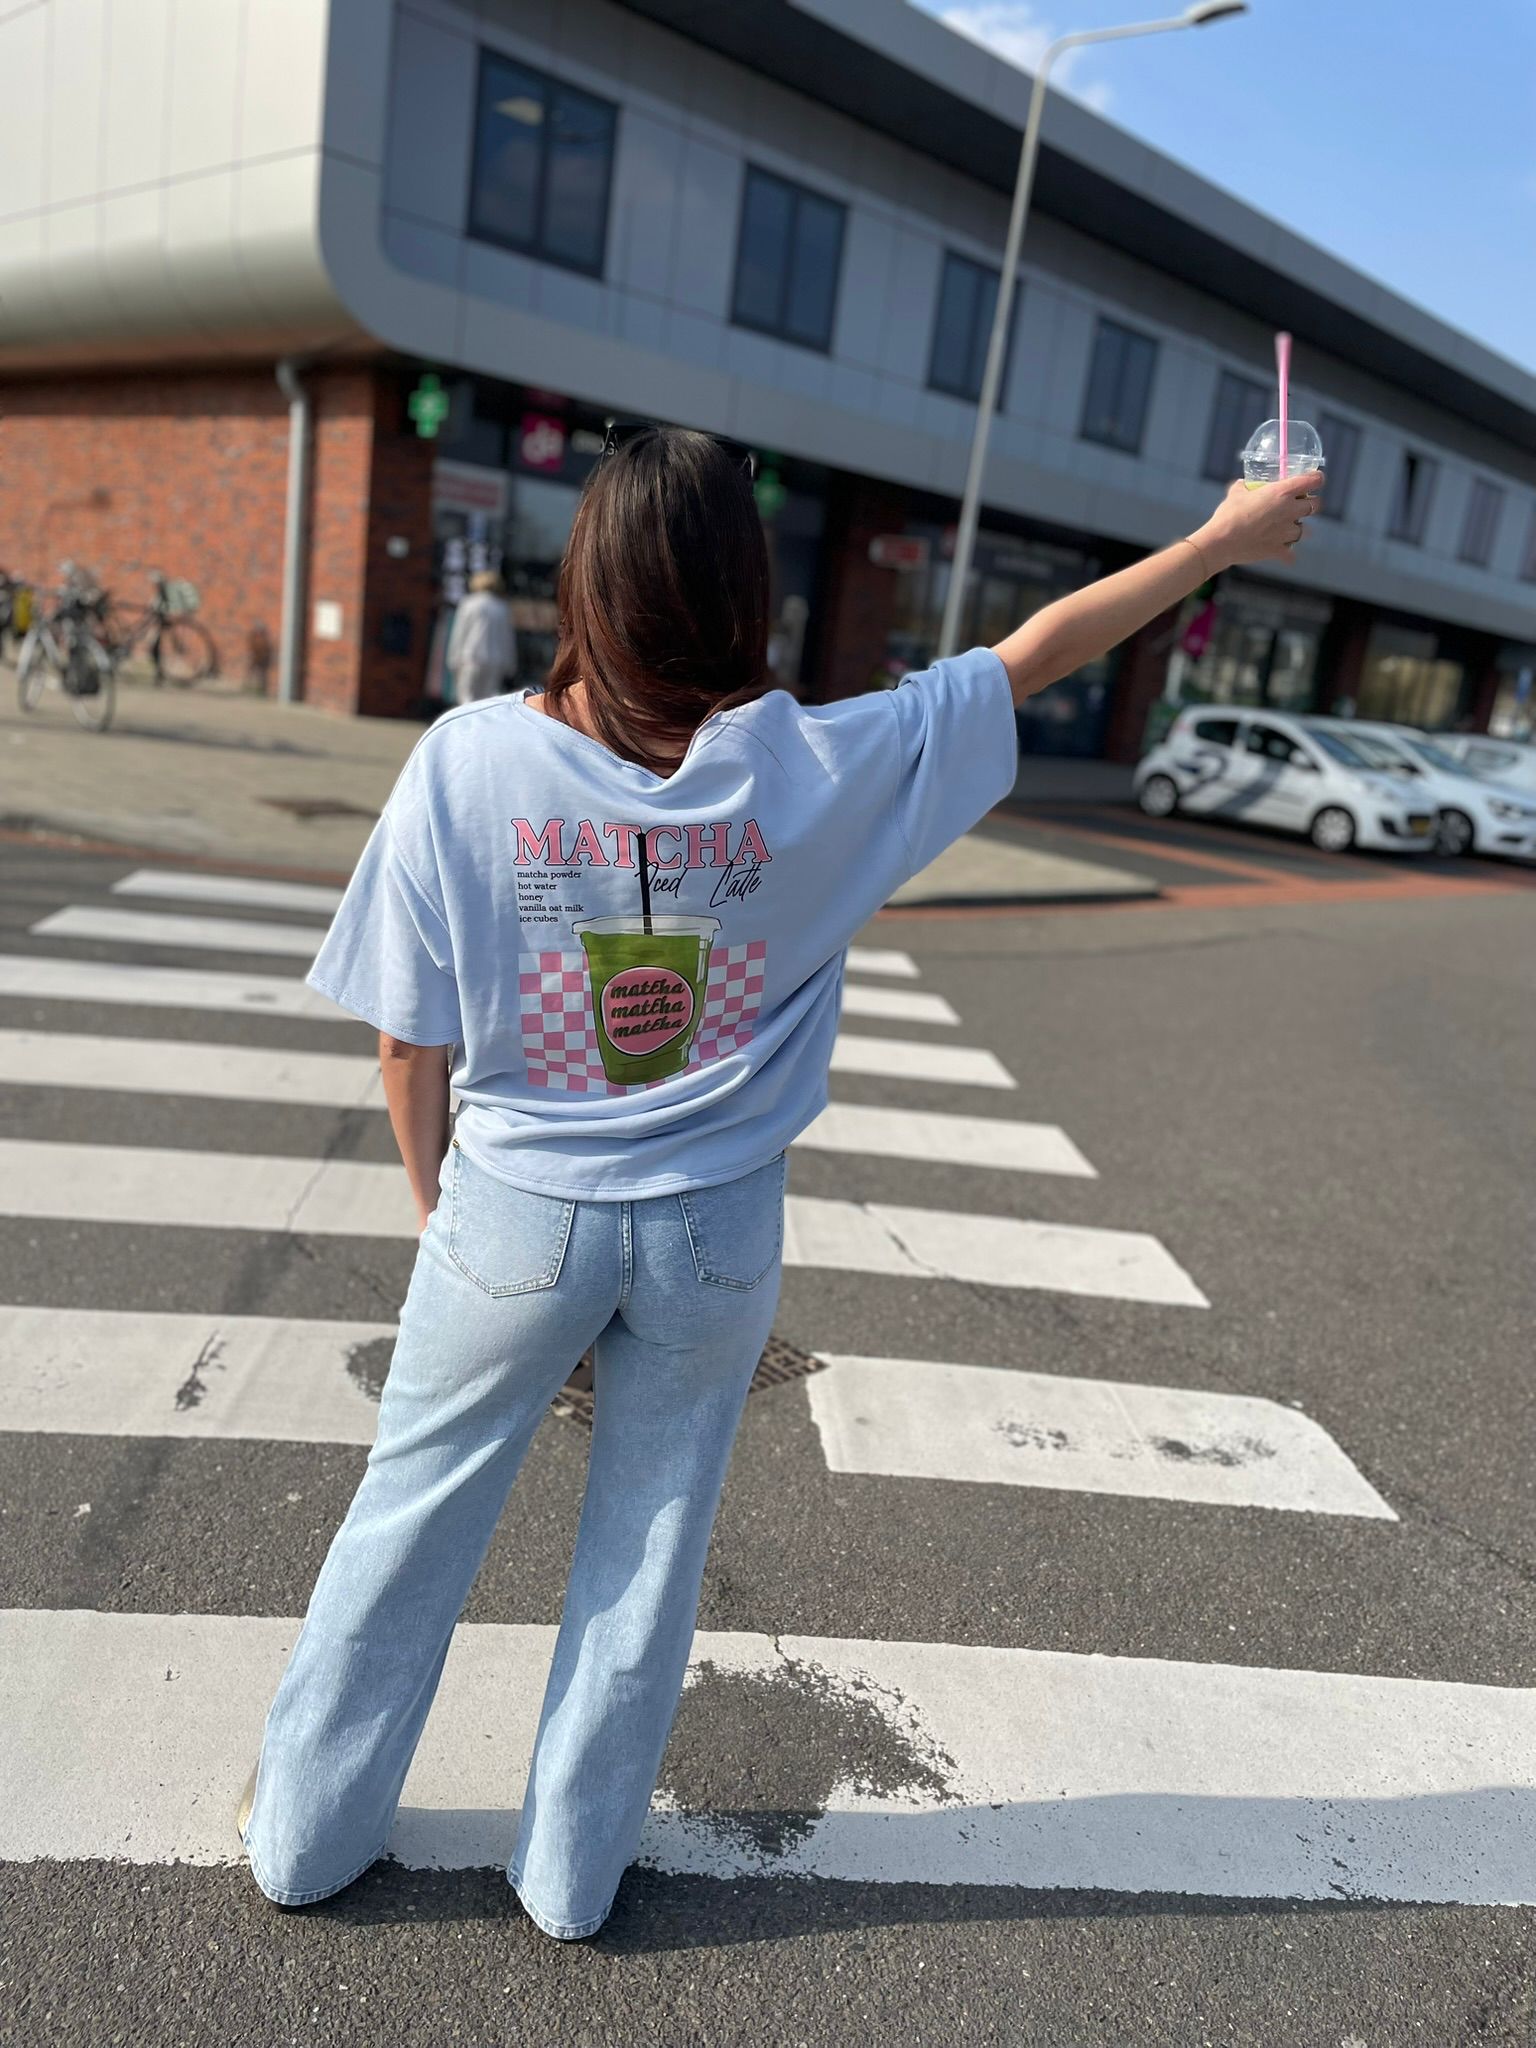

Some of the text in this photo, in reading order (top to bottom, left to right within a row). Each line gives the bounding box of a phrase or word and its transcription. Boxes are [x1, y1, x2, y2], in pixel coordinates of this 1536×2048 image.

[511, 818, 772, 869] MATCHA
[517, 870, 582, 880] matcha powder
[517, 882, 532, 890] hot
[709, 860, 762, 908] Latte
[518, 893, 544, 902] honey
[518, 904, 547, 912] vanilla
[564, 904, 584, 912] milk
[519, 915, 559, 923] ice cubes
[610, 978, 685, 998] matcha
[611, 996, 685, 1018] matcha
[612, 1016, 684, 1038] matcha
